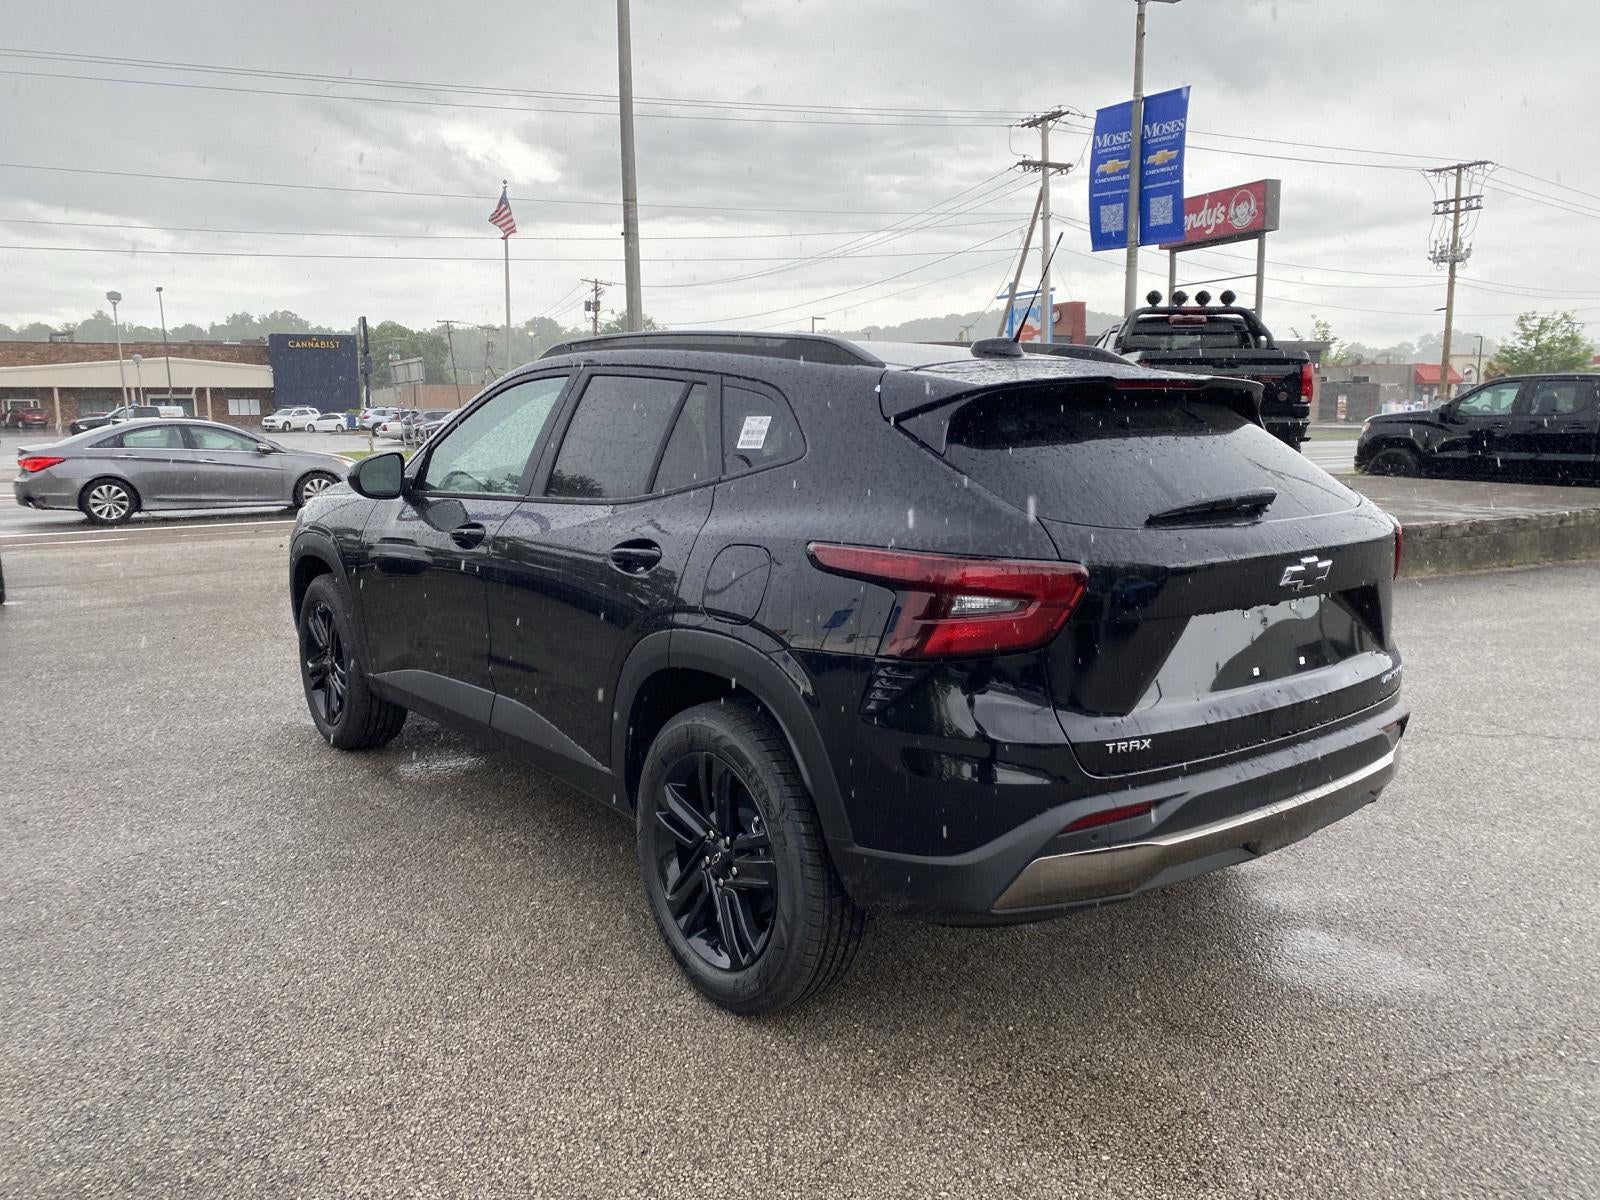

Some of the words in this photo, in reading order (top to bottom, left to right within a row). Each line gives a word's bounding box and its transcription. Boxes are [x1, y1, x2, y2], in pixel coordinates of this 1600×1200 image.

[1144, 118, 1185, 139] MOSES
[1148, 133, 1179, 144] CHEVROLET
[1098, 144, 1131, 154] CHEVROLET
[1145, 165, 1178, 175] CHEVROLET
[1095, 174, 1130, 184] CHEVROLET
[1184, 199, 1227, 234] ndy's
[1105, 738, 1152, 754] TRAX
